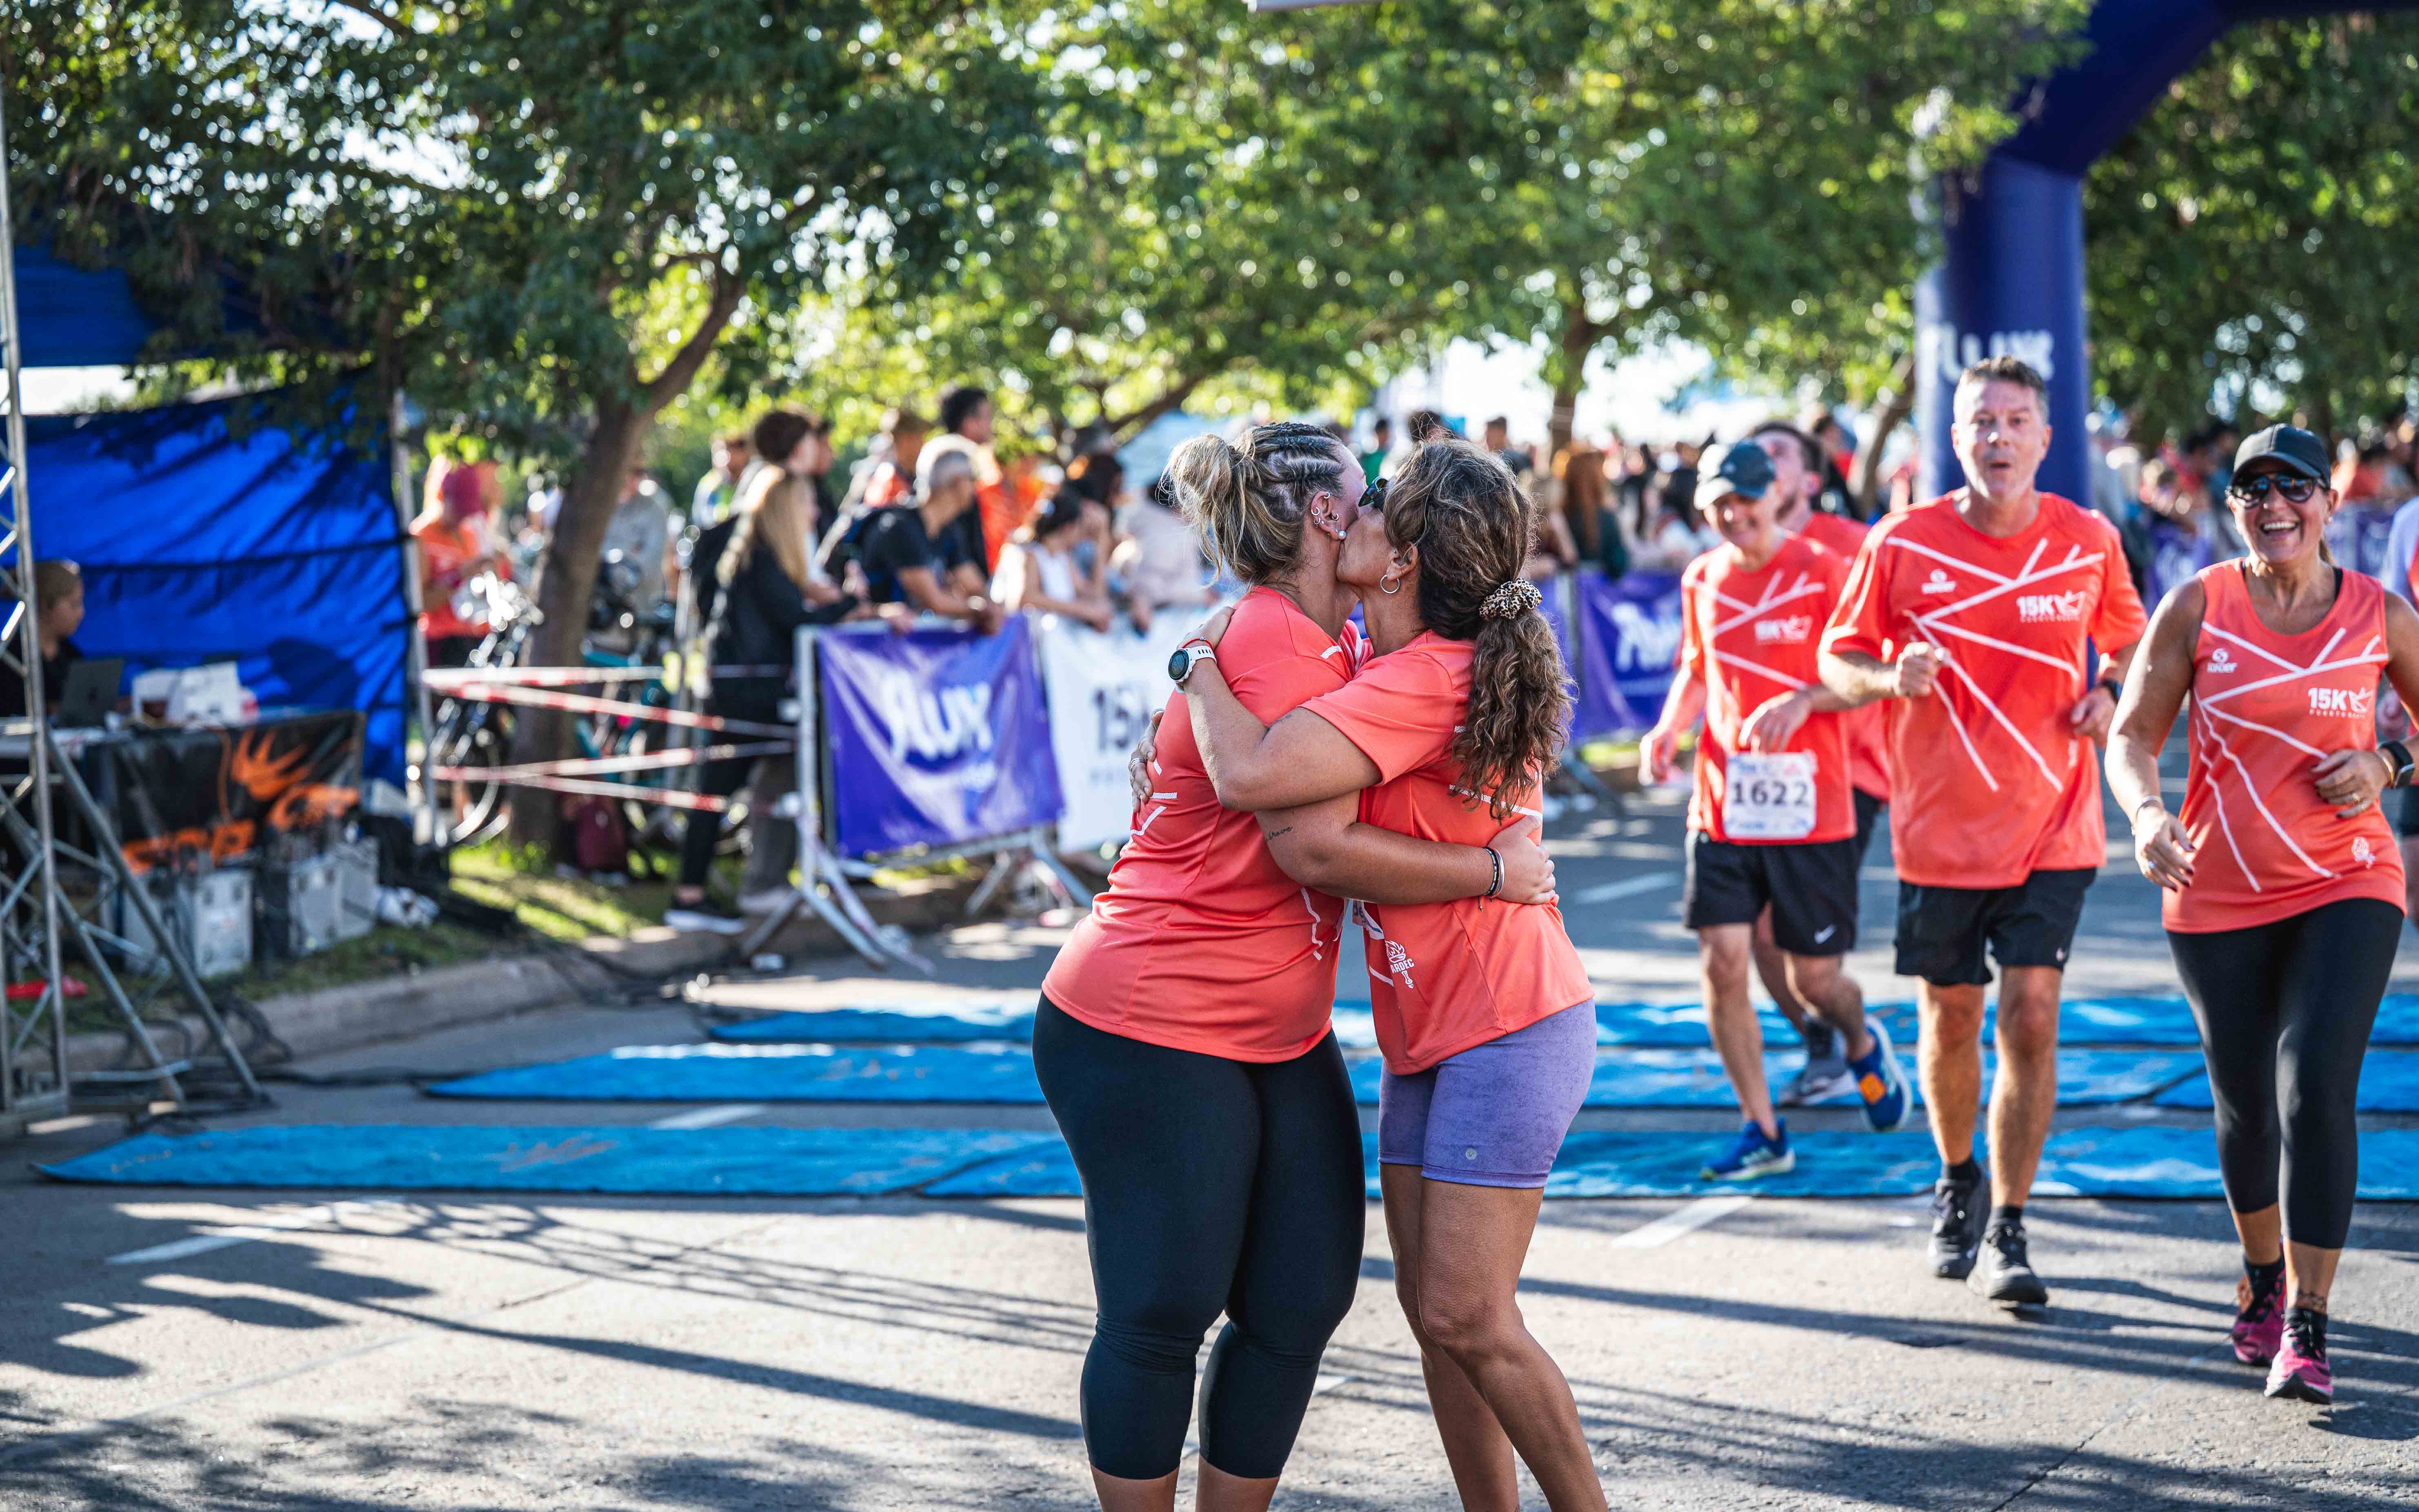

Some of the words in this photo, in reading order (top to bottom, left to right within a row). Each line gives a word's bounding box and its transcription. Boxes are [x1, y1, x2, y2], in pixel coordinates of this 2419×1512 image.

[2308, 687, 2348, 711] 15K
[1733, 780, 1810, 807] 1622
[1390, 958, 1415, 973] ARDEC
